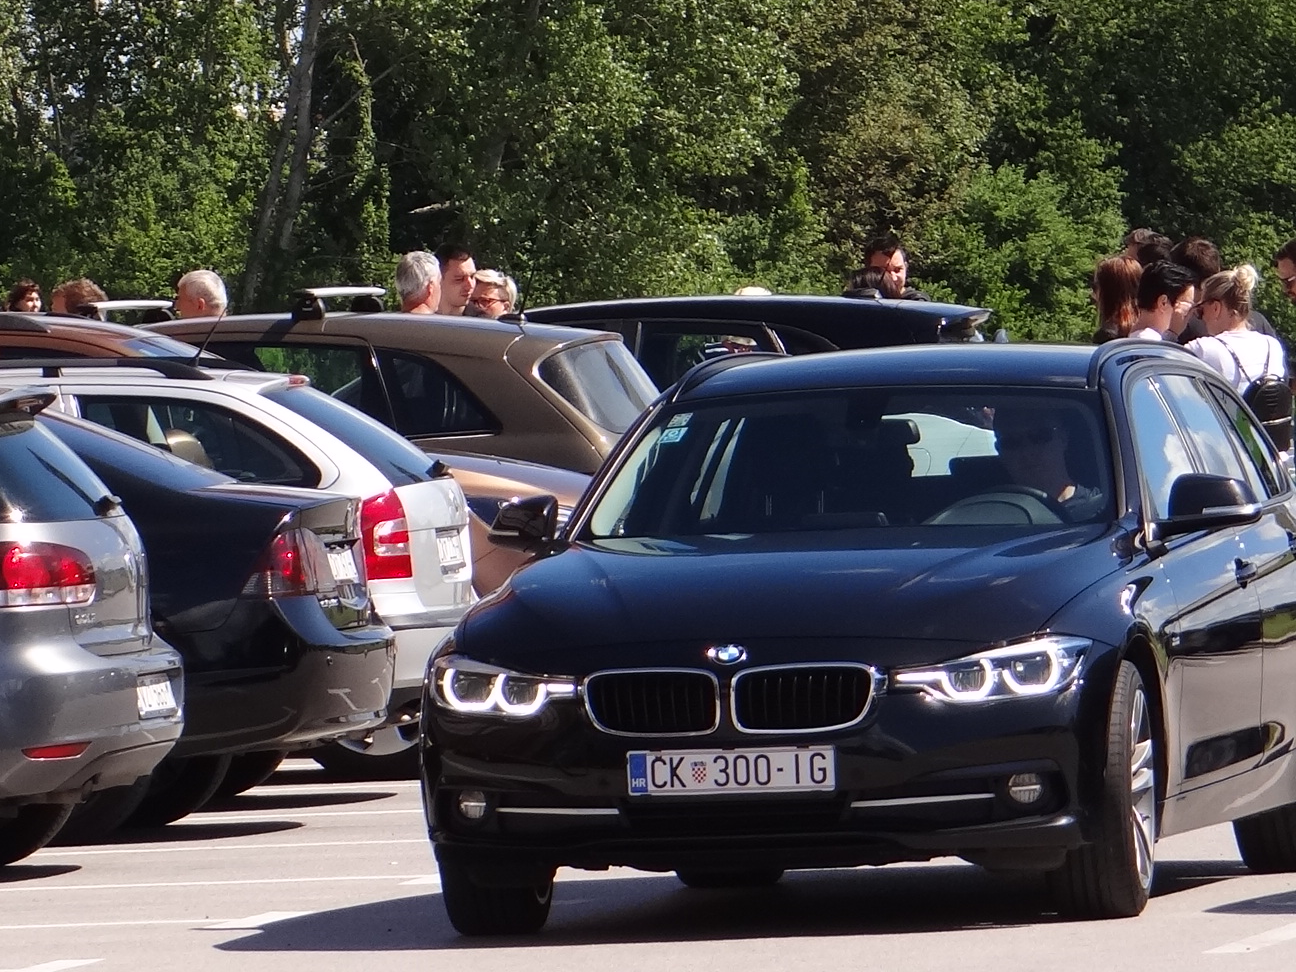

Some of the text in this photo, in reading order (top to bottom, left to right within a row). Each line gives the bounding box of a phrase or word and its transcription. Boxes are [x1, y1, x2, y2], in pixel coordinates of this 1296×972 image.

[632, 751, 828, 789] HR ČK 300-IG
